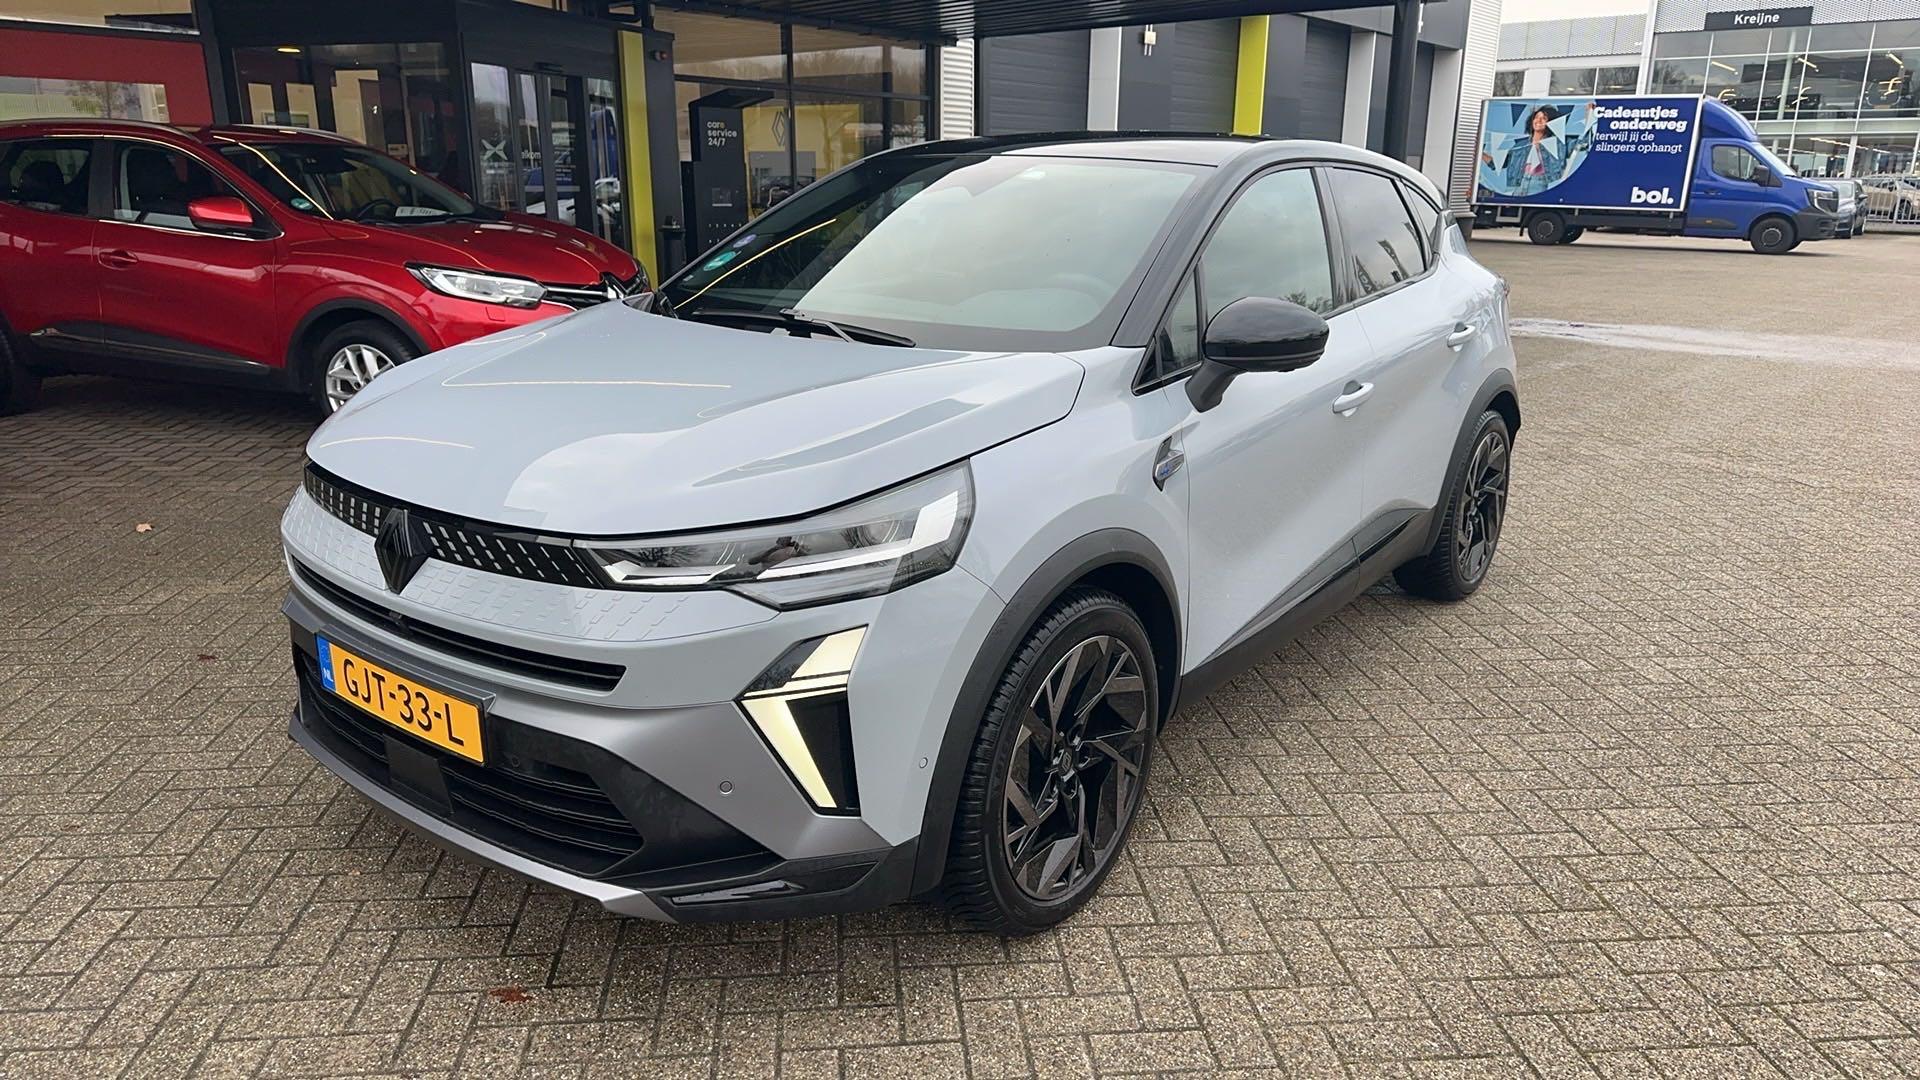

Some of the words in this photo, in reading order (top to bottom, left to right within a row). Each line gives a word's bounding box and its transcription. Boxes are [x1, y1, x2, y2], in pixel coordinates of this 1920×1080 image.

[1734, 13, 1780, 26] Kreijne
[1594, 106, 1679, 120] Cadeautjes
[1610, 119, 1687, 132] onderweg
[707, 129, 738, 138] service
[1596, 131, 1628, 142] terwijl
[1629, 131, 1640, 142] jij
[1641, 131, 1655, 141] de
[708, 138, 726, 147] 24/7
[1595, 142, 1636, 153] slingers
[1637, 142, 1683, 154] ophangt
[1631, 186, 1674, 204] bol.
[323, 667, 334, 682] NL
[343, 658, 465, 746] GJT-33-L
